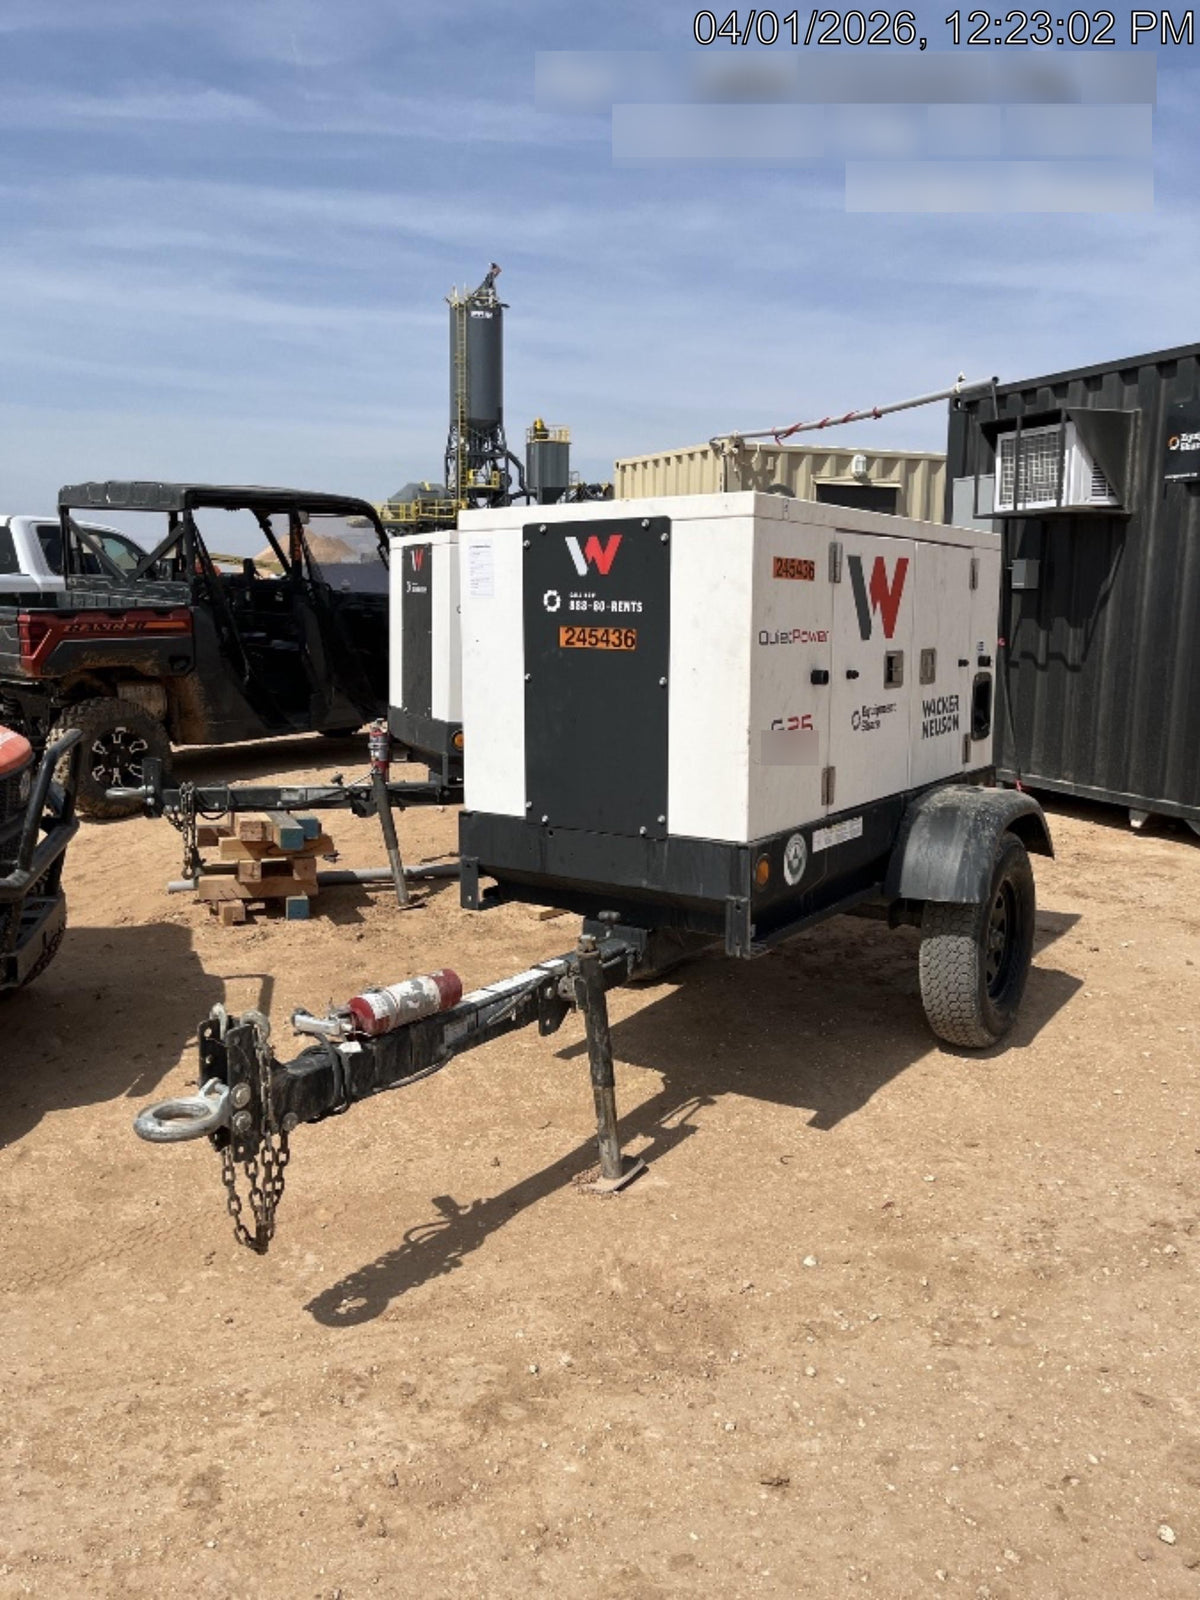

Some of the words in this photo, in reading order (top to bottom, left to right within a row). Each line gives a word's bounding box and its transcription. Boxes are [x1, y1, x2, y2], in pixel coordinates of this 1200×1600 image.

[776, 557, 815, 580] 245436
[564, 627, 636, 648] 245436
[758, 629, 830, 645] QuietPower
[922, 694, 960, 718] WACKER
[922, 714, 960, 738] NEUSON
